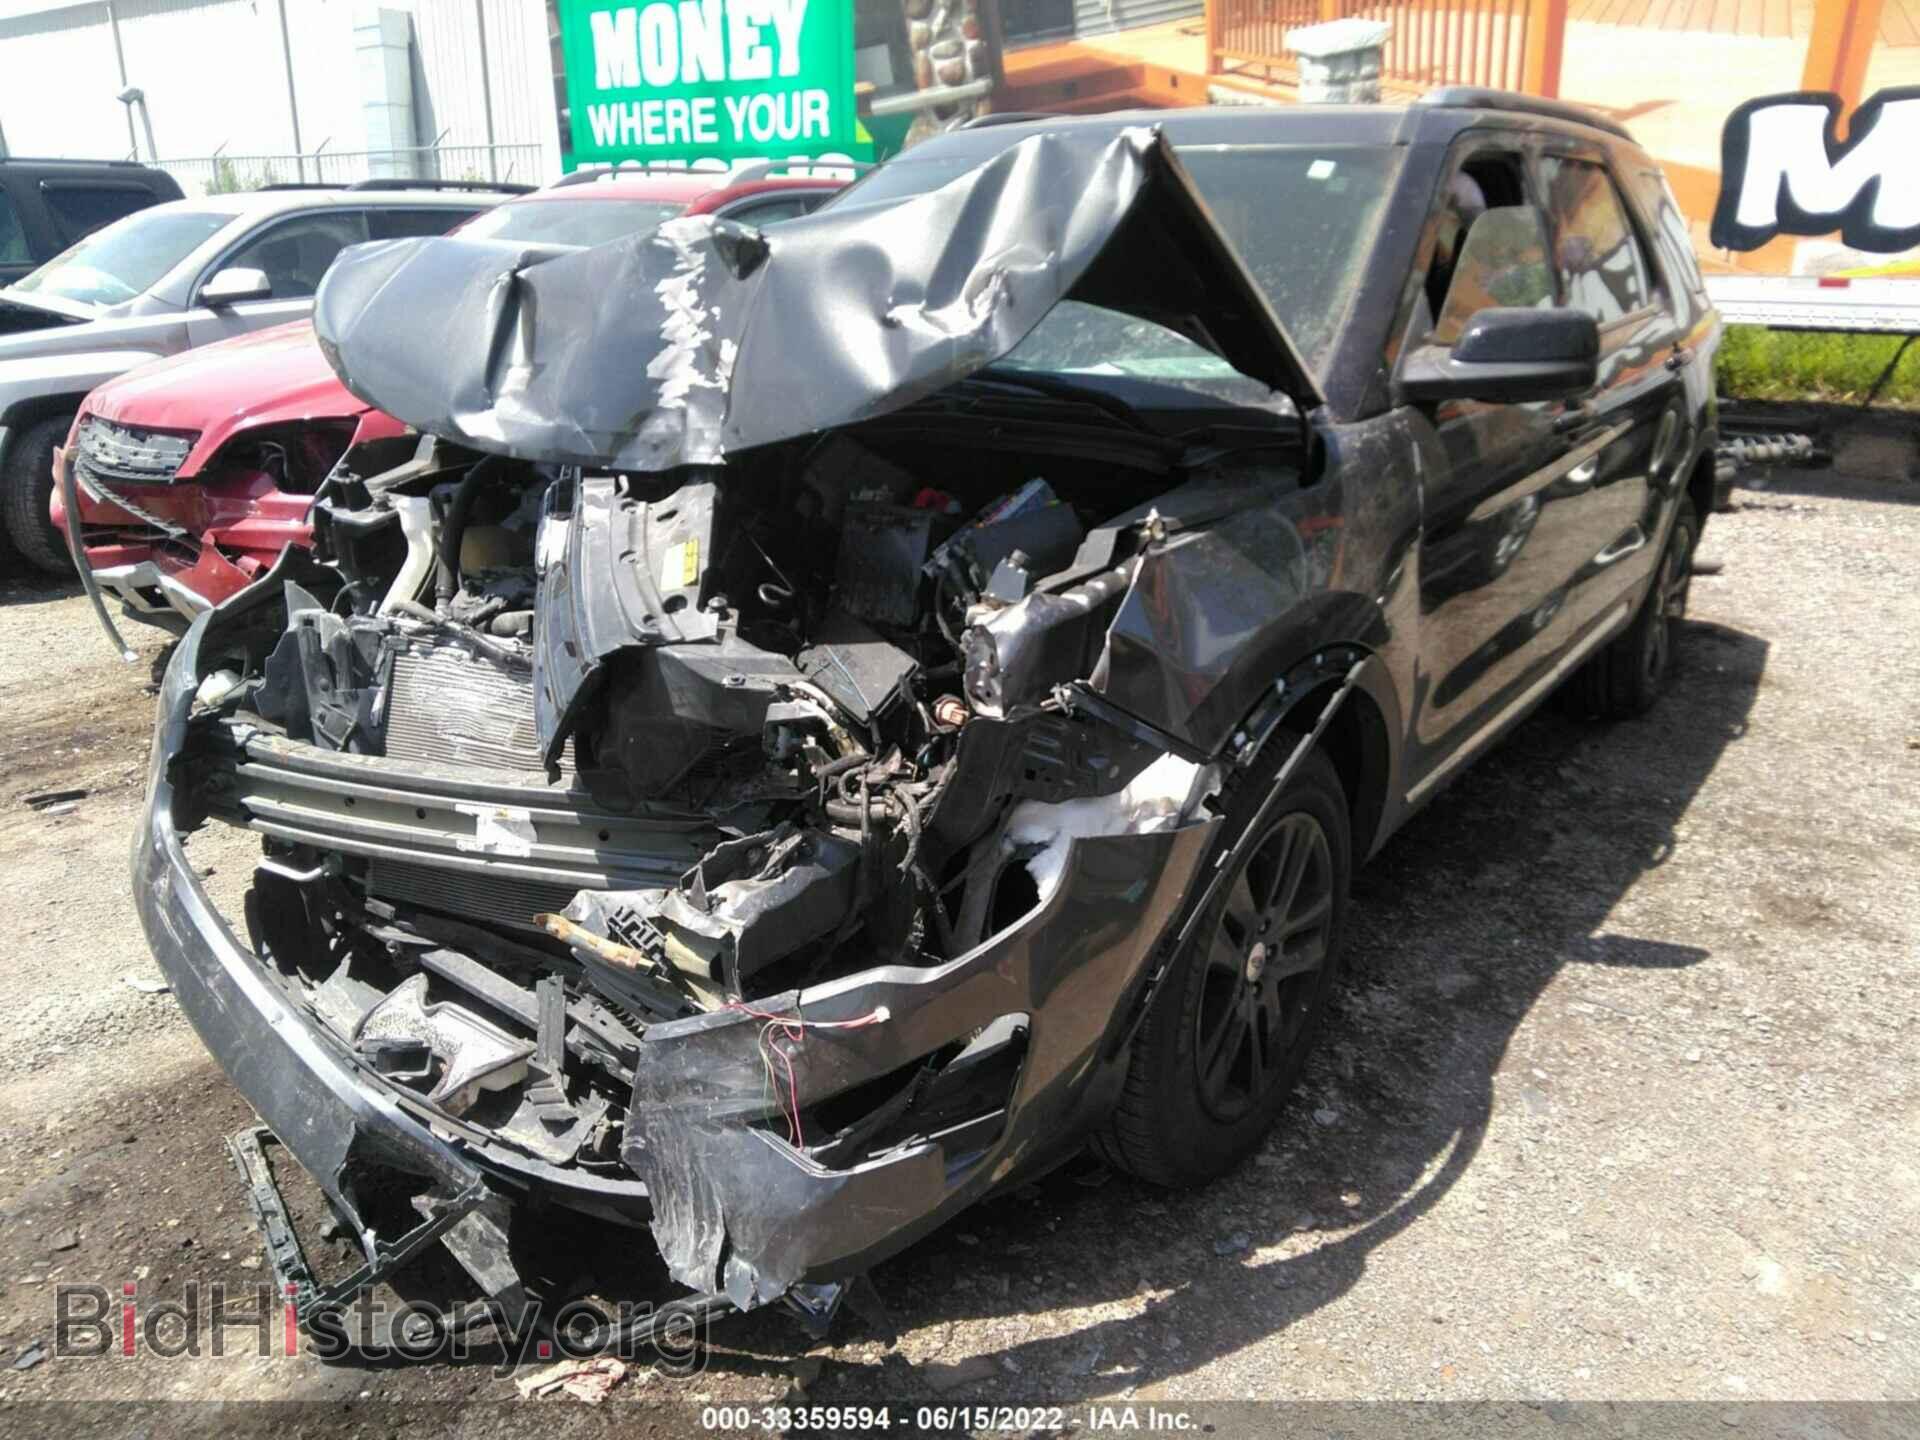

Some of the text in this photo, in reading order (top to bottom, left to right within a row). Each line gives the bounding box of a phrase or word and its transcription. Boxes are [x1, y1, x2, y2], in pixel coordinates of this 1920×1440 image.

[590, 0, 808, 90] MONEY
[587, 89, 830, 146] WHERE YOUR
